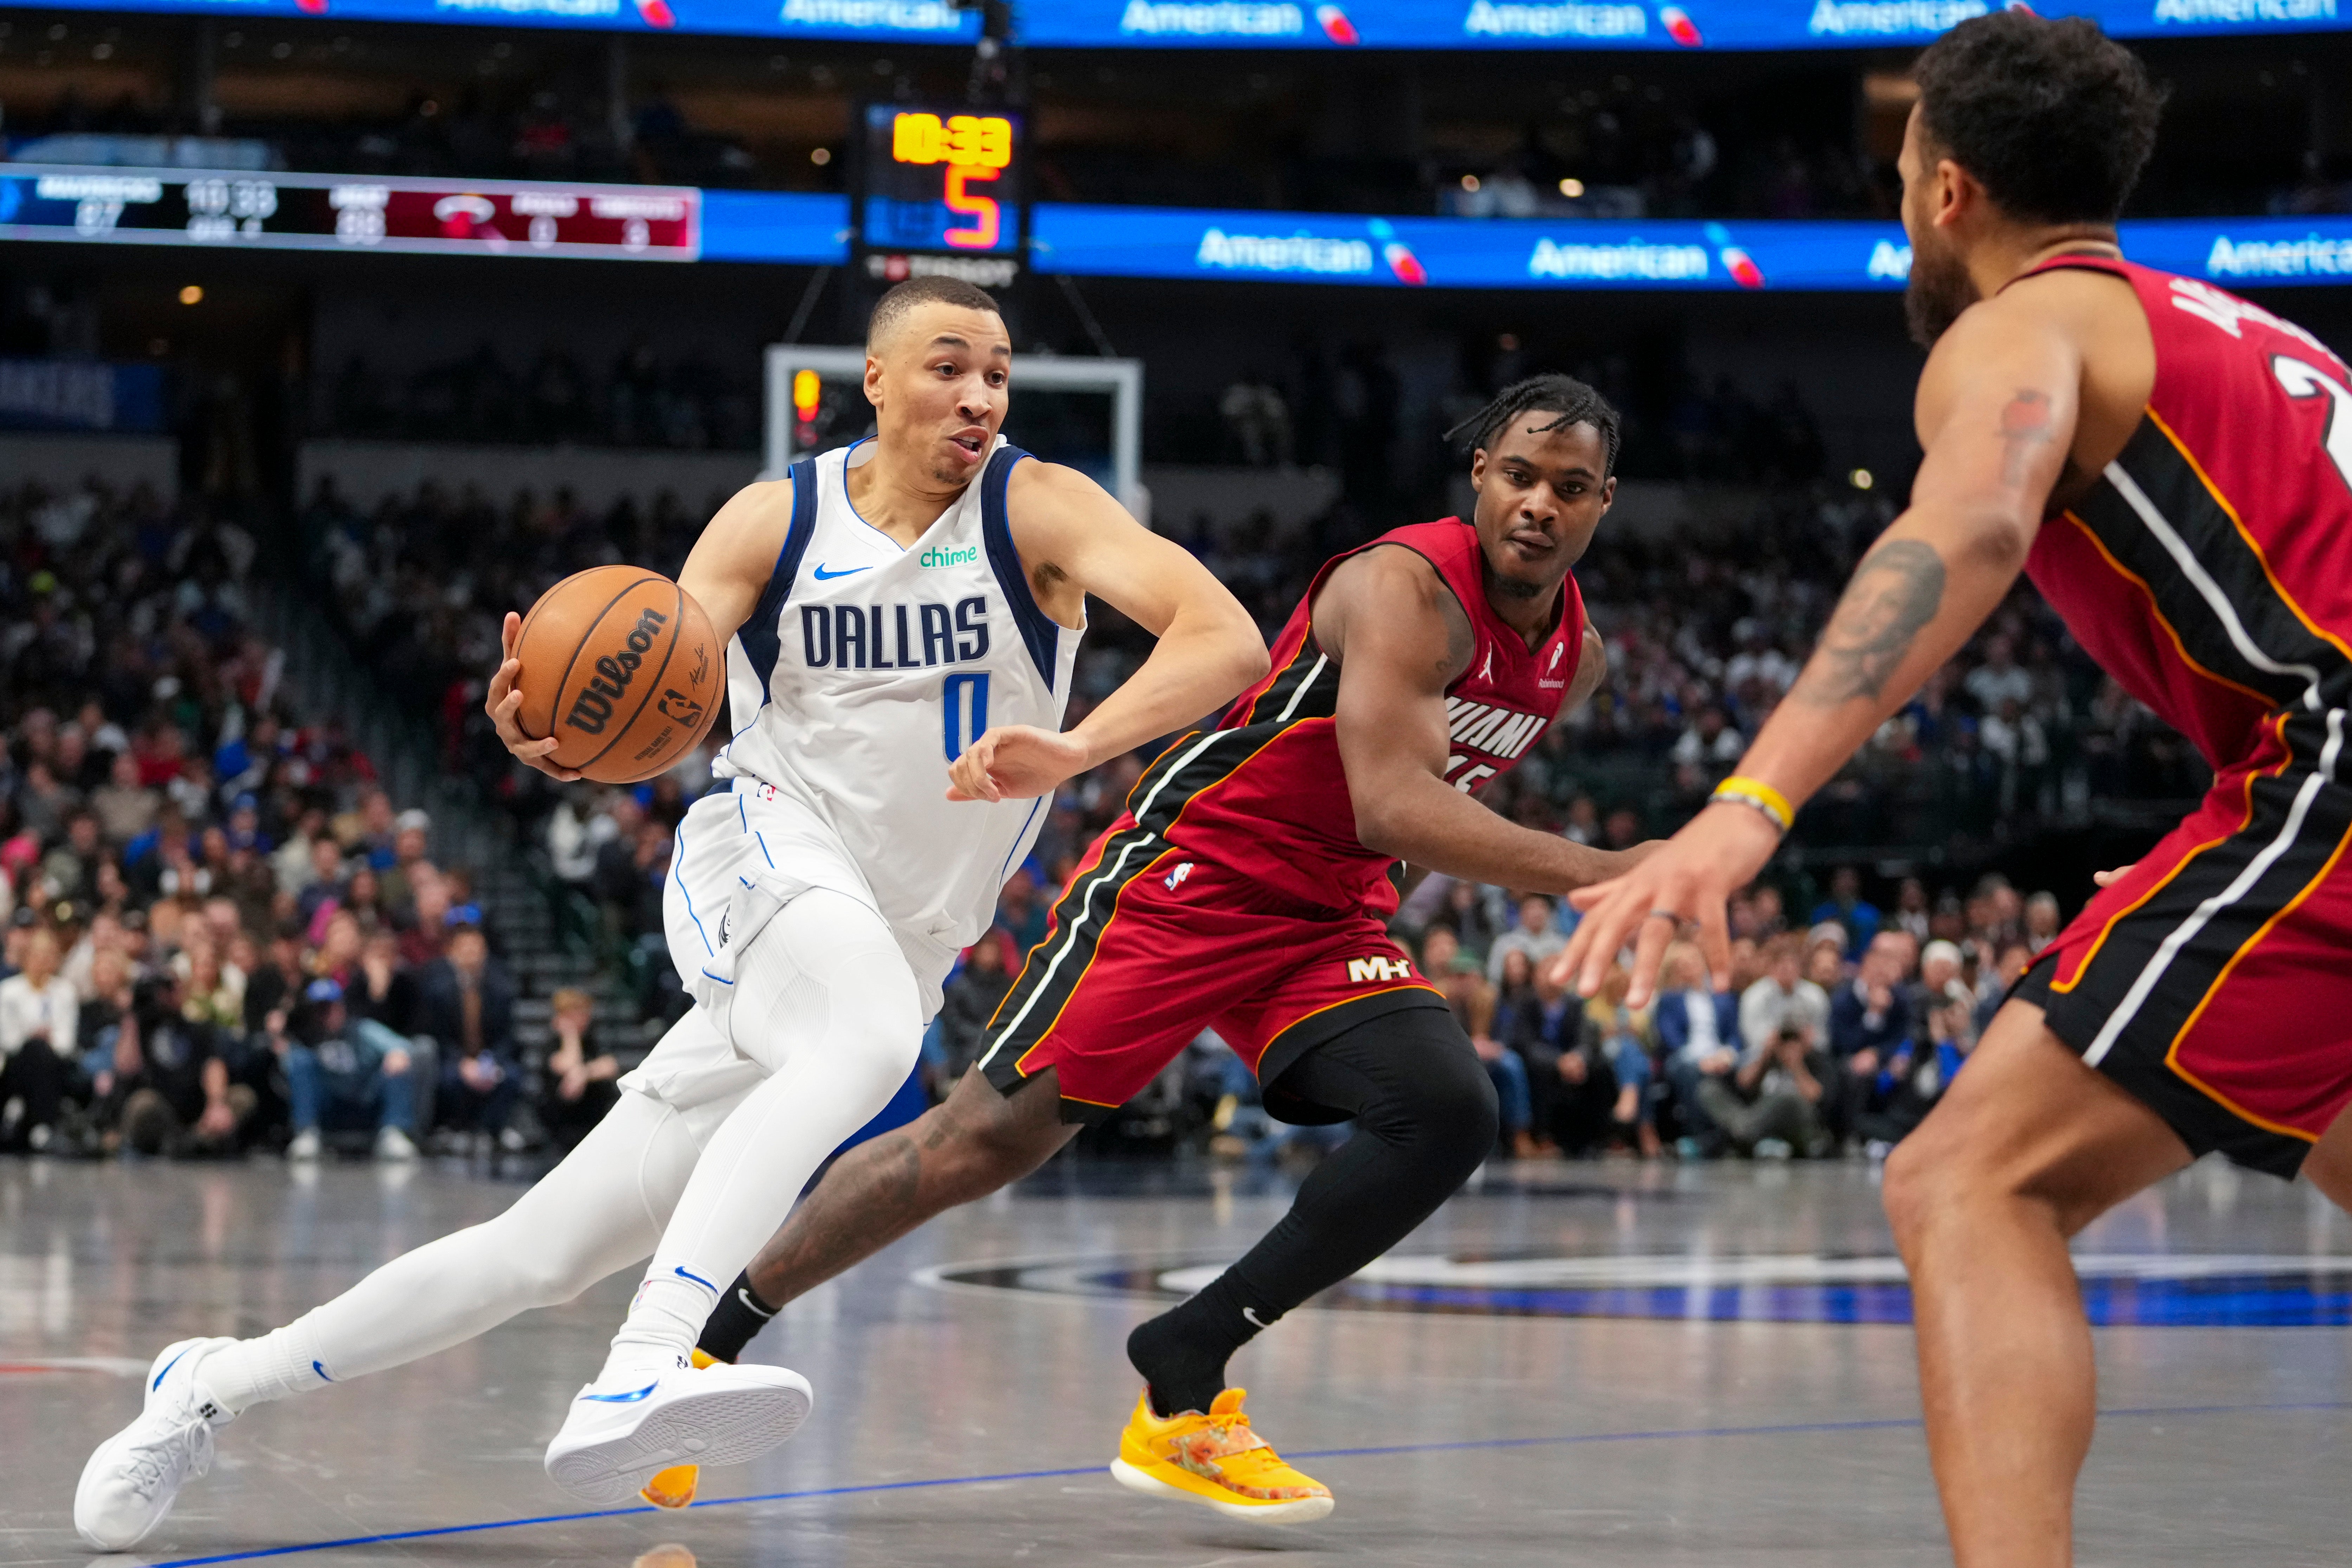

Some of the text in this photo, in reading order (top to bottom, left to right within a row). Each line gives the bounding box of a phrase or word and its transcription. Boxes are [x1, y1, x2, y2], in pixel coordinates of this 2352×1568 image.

[1121, 0, 1303, 35] American
[1465, 0, 1648, 36] American
[893, 112, 1011, 168] 10:33
[944, 163, 1000, 249] 5
[1197, 227, 1373, 276] American
[1528, 236, 1708, 280] American
[920, 546, 977, 568] chime
[799, 595, 991, 671] DALLAS
[565, 607, 668, 735] Wilson
[941, 670, 992, 765] 0
